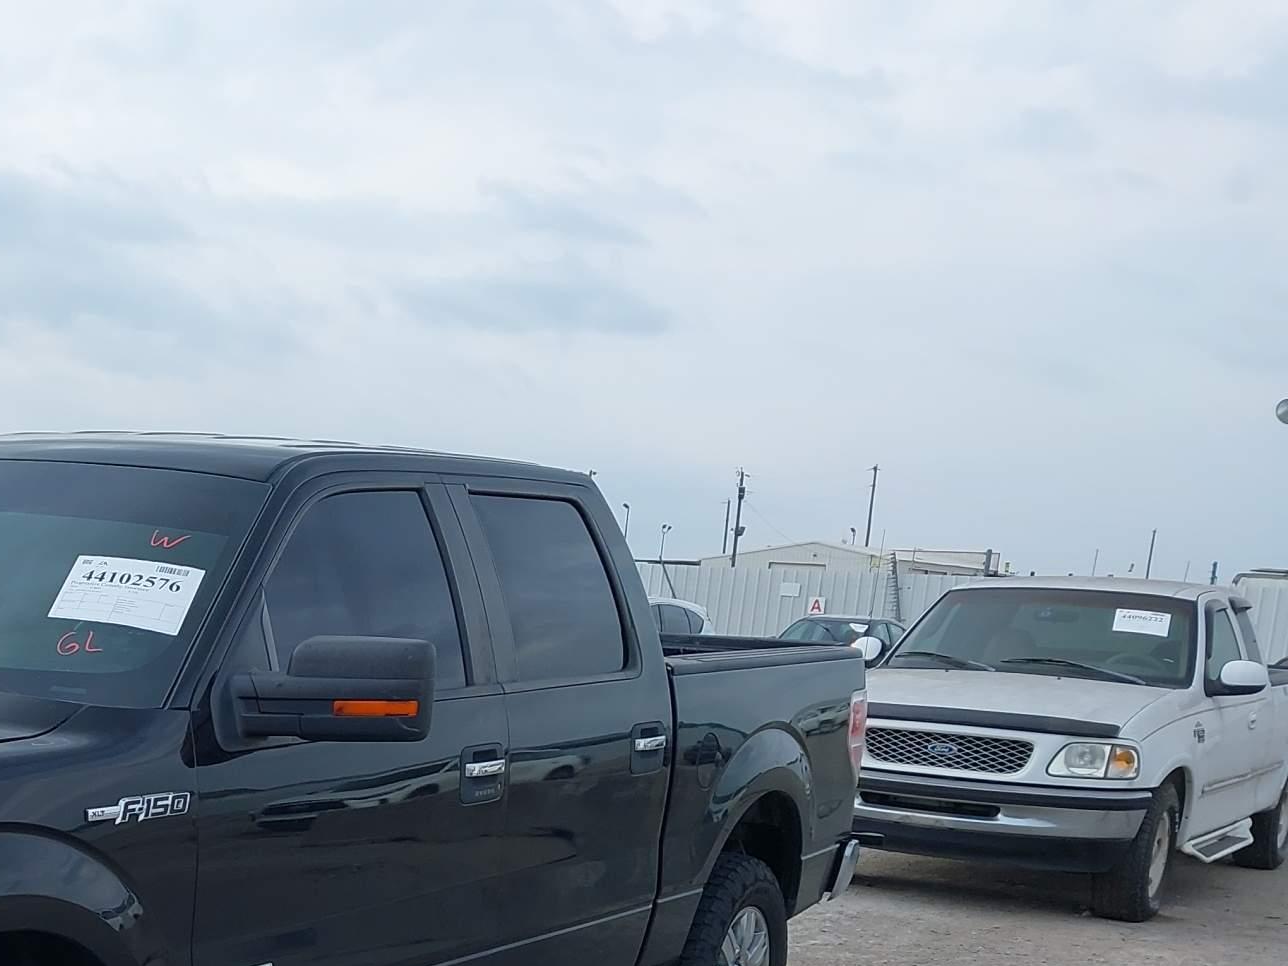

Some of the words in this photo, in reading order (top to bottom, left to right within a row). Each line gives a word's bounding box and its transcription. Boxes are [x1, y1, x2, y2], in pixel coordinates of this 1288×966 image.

[82, 569, 183, 593] 44102576
[810, 599, 822, 612] A
[115, 792, 191, 825] F-150
